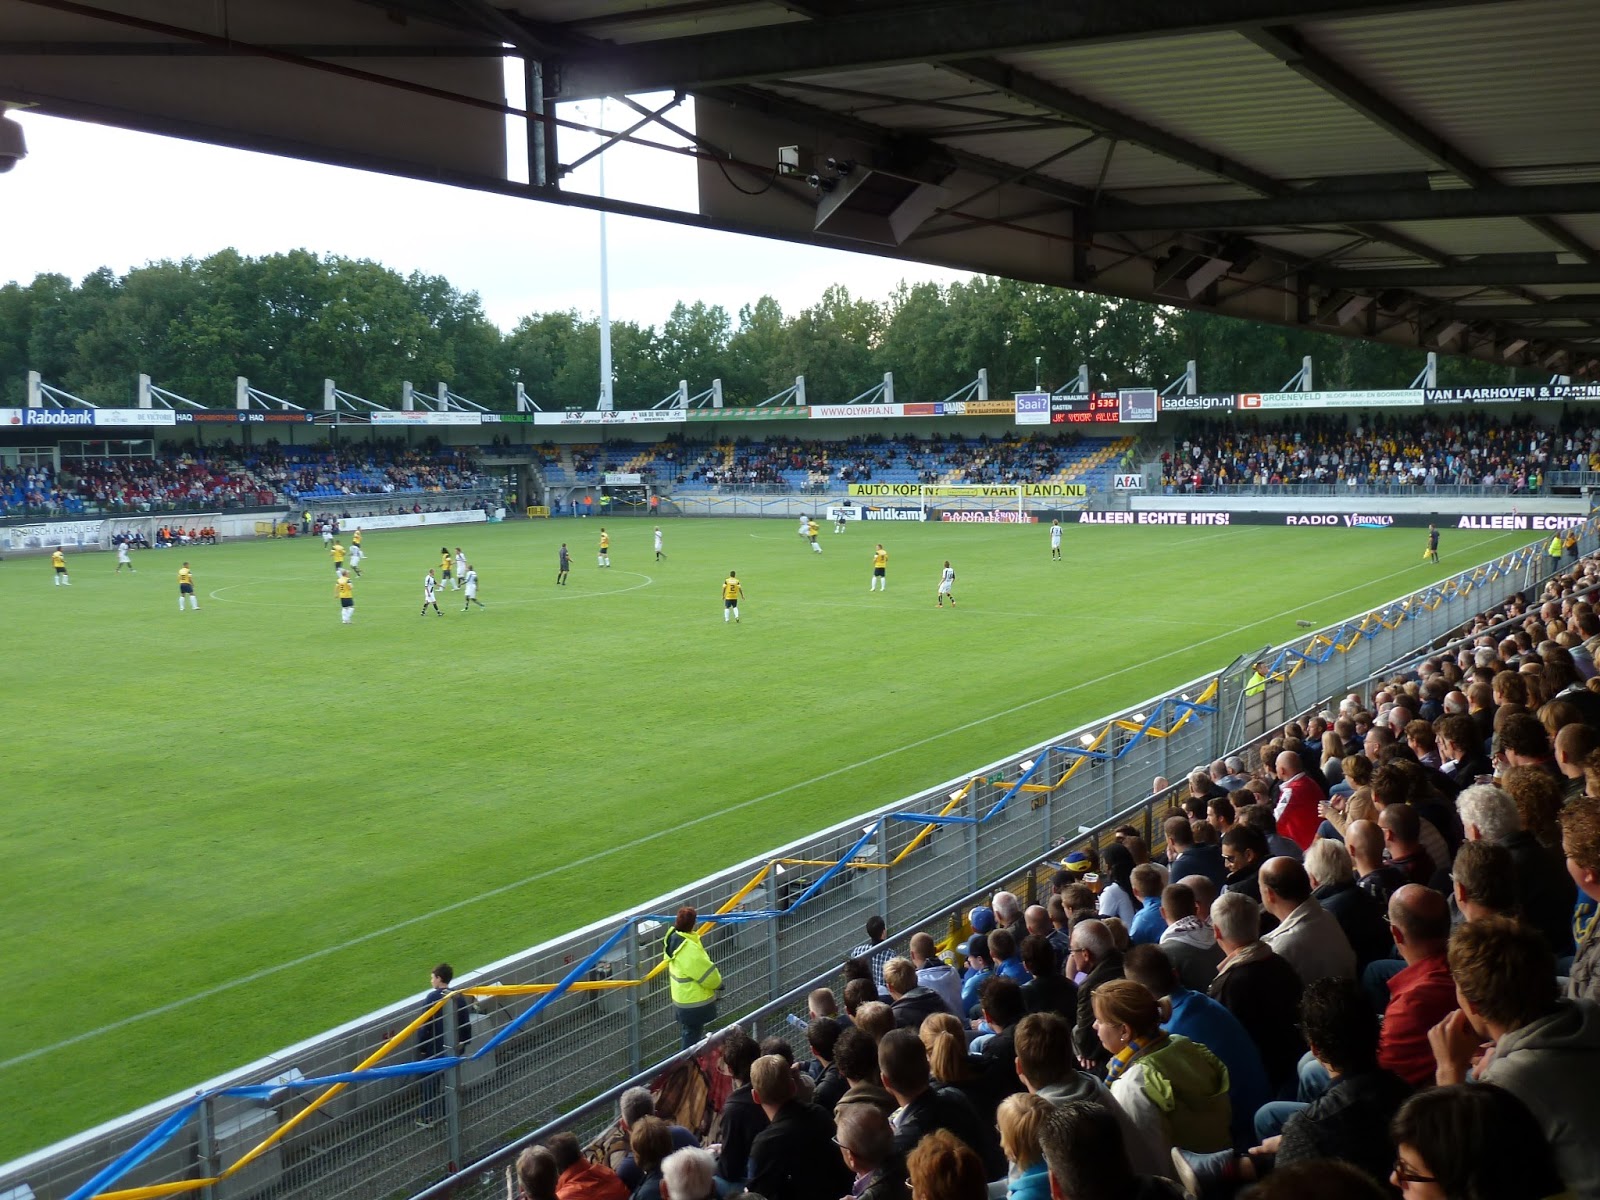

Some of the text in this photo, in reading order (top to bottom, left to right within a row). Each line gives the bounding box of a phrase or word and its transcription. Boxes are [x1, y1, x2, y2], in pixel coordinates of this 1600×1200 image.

[1262, 393, 1321, 401] GROENEVELD
[1426, 389, 1452, 399] VAN
[1456, 387, 1536, 399] LAARHOVEN
[1540, 386, 1550, 397] &
[1019, 399, 1047, 410] Saai?
[1162, 395, 1234, 409] isadesign.nl
[27, 410, 92, 424] Rabobank
[820, 407, 894, 416] WWW.OLYMPIA.NL
[857, 485, 890, 495] AUTO
[866, 508, 928, 520] wildkamp
[949, 515, 1000, 523] HYPOTHEEK
[1079, 511, 1230, 525] ALLEEN ECHTE HITS!
[1286, 515, 1338, 525] RADIO
[1458, 515, 1527, 529] ALLEEN
[730, 584, 735, 592] 2
